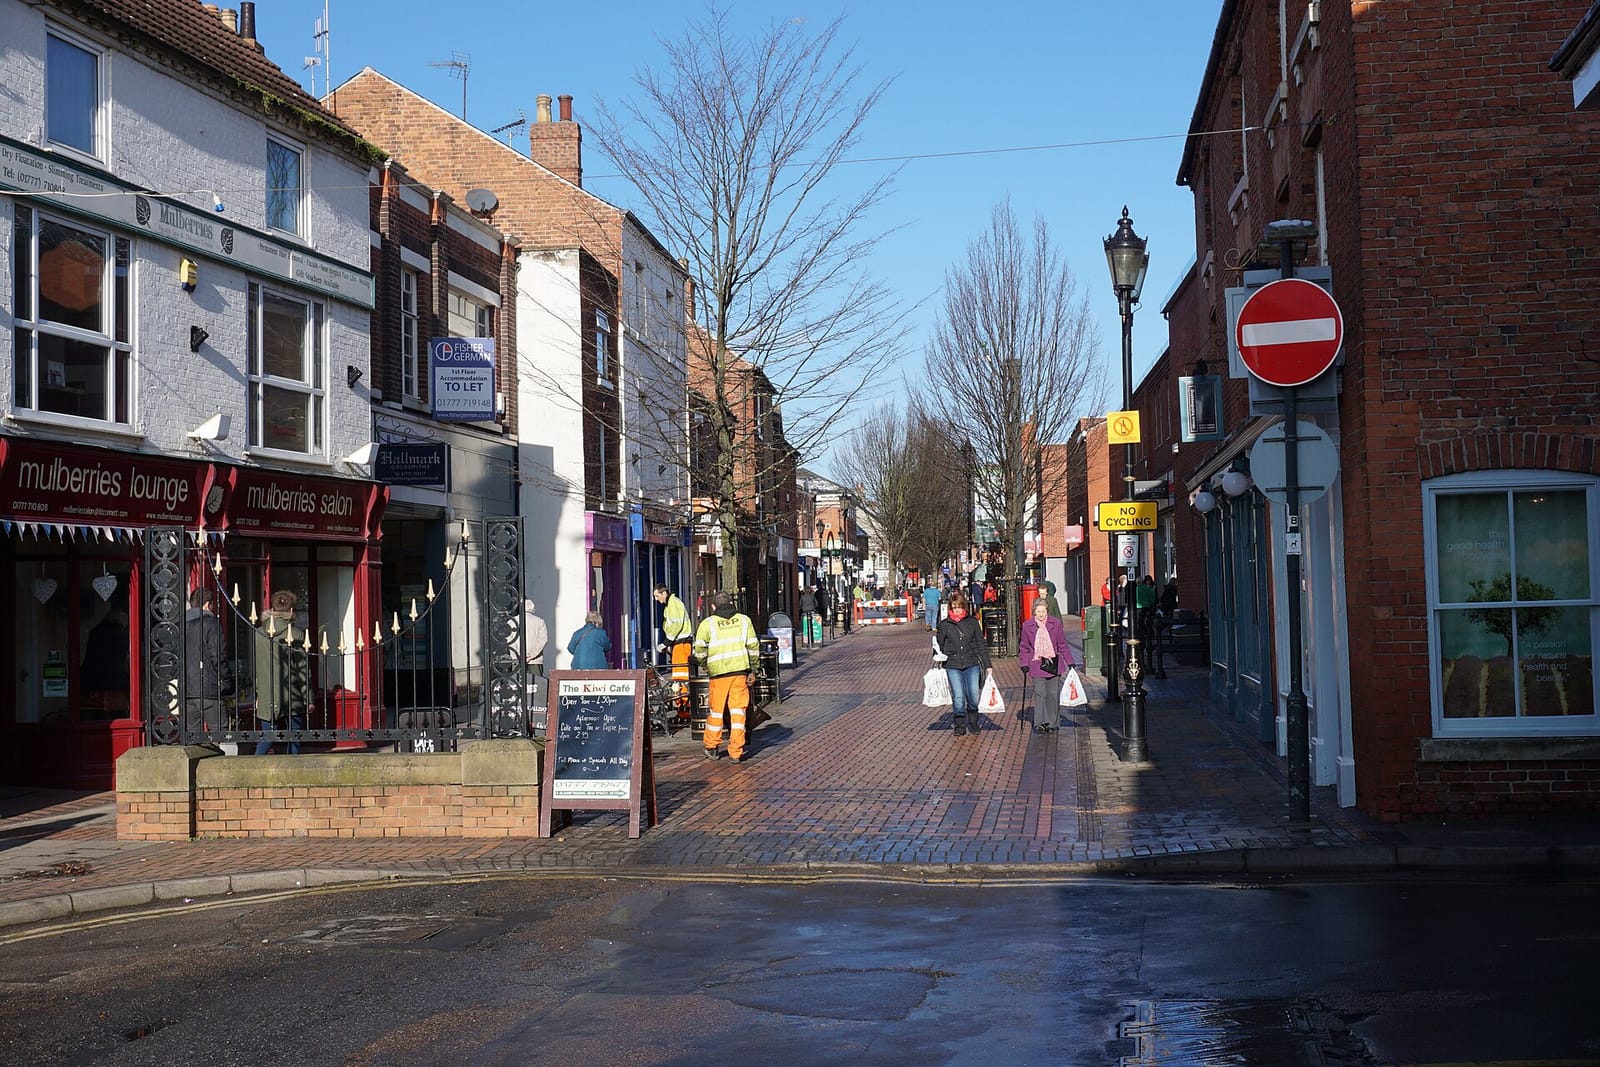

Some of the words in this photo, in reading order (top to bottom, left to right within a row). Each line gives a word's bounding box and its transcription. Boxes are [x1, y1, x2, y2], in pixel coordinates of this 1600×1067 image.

[2, 148, 12, 161] Dry
[160, 203, 213, 240] Mulberries
[454, 343, 483, 352] FISHER
[453, 352, 491, 361] GERMAN
[444, 382, 460, 392] TO
[463, 382, 483, 392] LET
[437, 399, 460, 407] 01777
[463, 399, 491, 408] 719148
[380, 451, 441, 464] Hallmark
[18, 457, 122, 496] mulberries
[129, 466, 189, 511] lounge
[247, 482, 316, 513] mulberries
[320, 489, 353, 516] salon
[1120, 507, 1136, 515] NO
[1105, 517, 1152, 527] CYCLING
[1533, 640, 1567, 650] passion
[1523, 662, 1549, 671] health
[1550, 661, 1567, 671] and
[583, 684, 606, 692] Kiwi
[609, 684, 630, 692] Café
[561, 696, 577, 709] Open
[618, 757, 628, 766] Day
